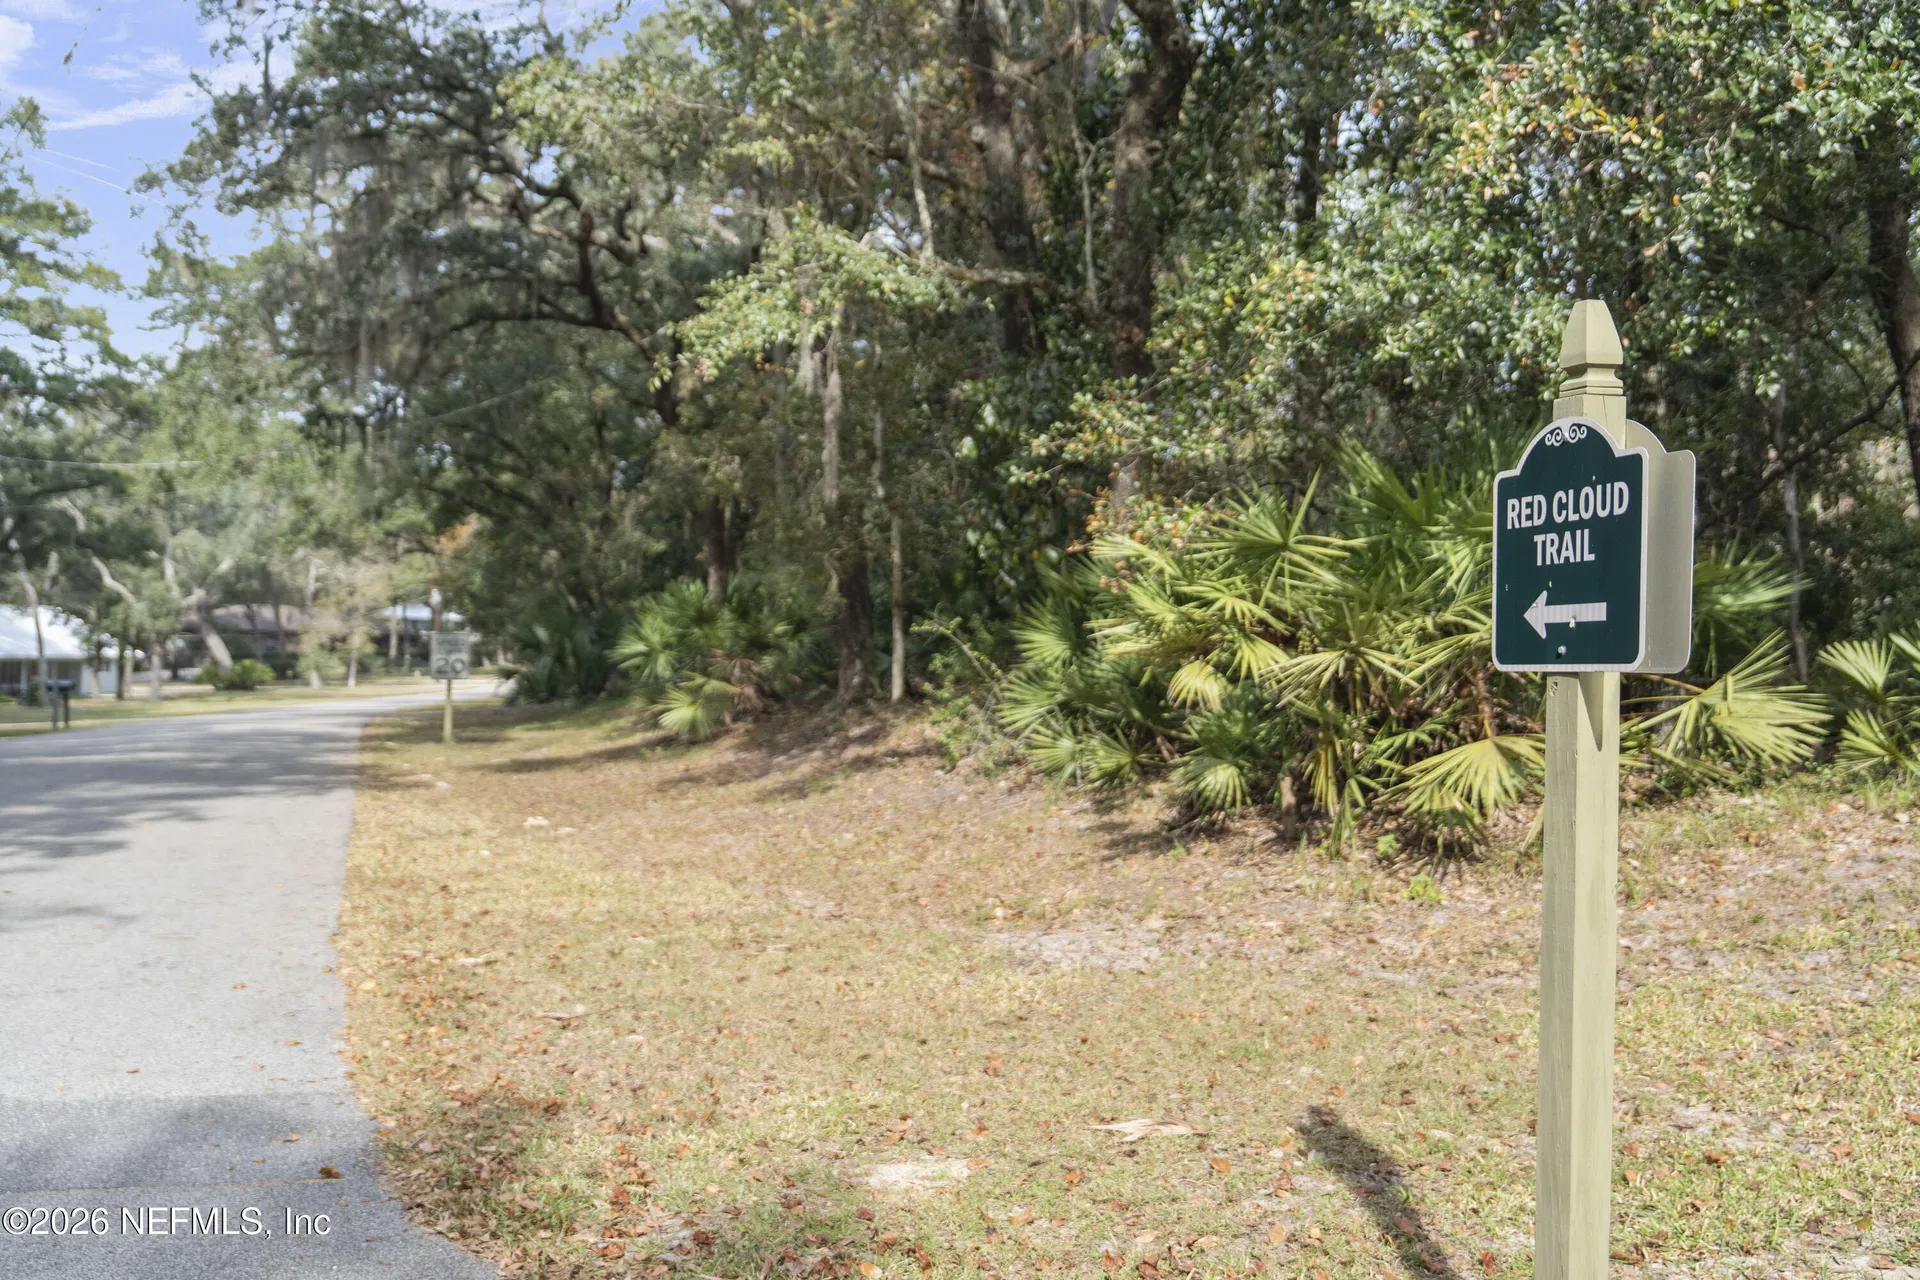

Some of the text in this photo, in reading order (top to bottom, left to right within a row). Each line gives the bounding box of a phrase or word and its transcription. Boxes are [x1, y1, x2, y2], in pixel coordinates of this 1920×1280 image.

[1506, 481, 1630, 530] RED CLOUD
[1533, 528, 1596, 567] TRAIL
[435, 657, 466, 674] 20
